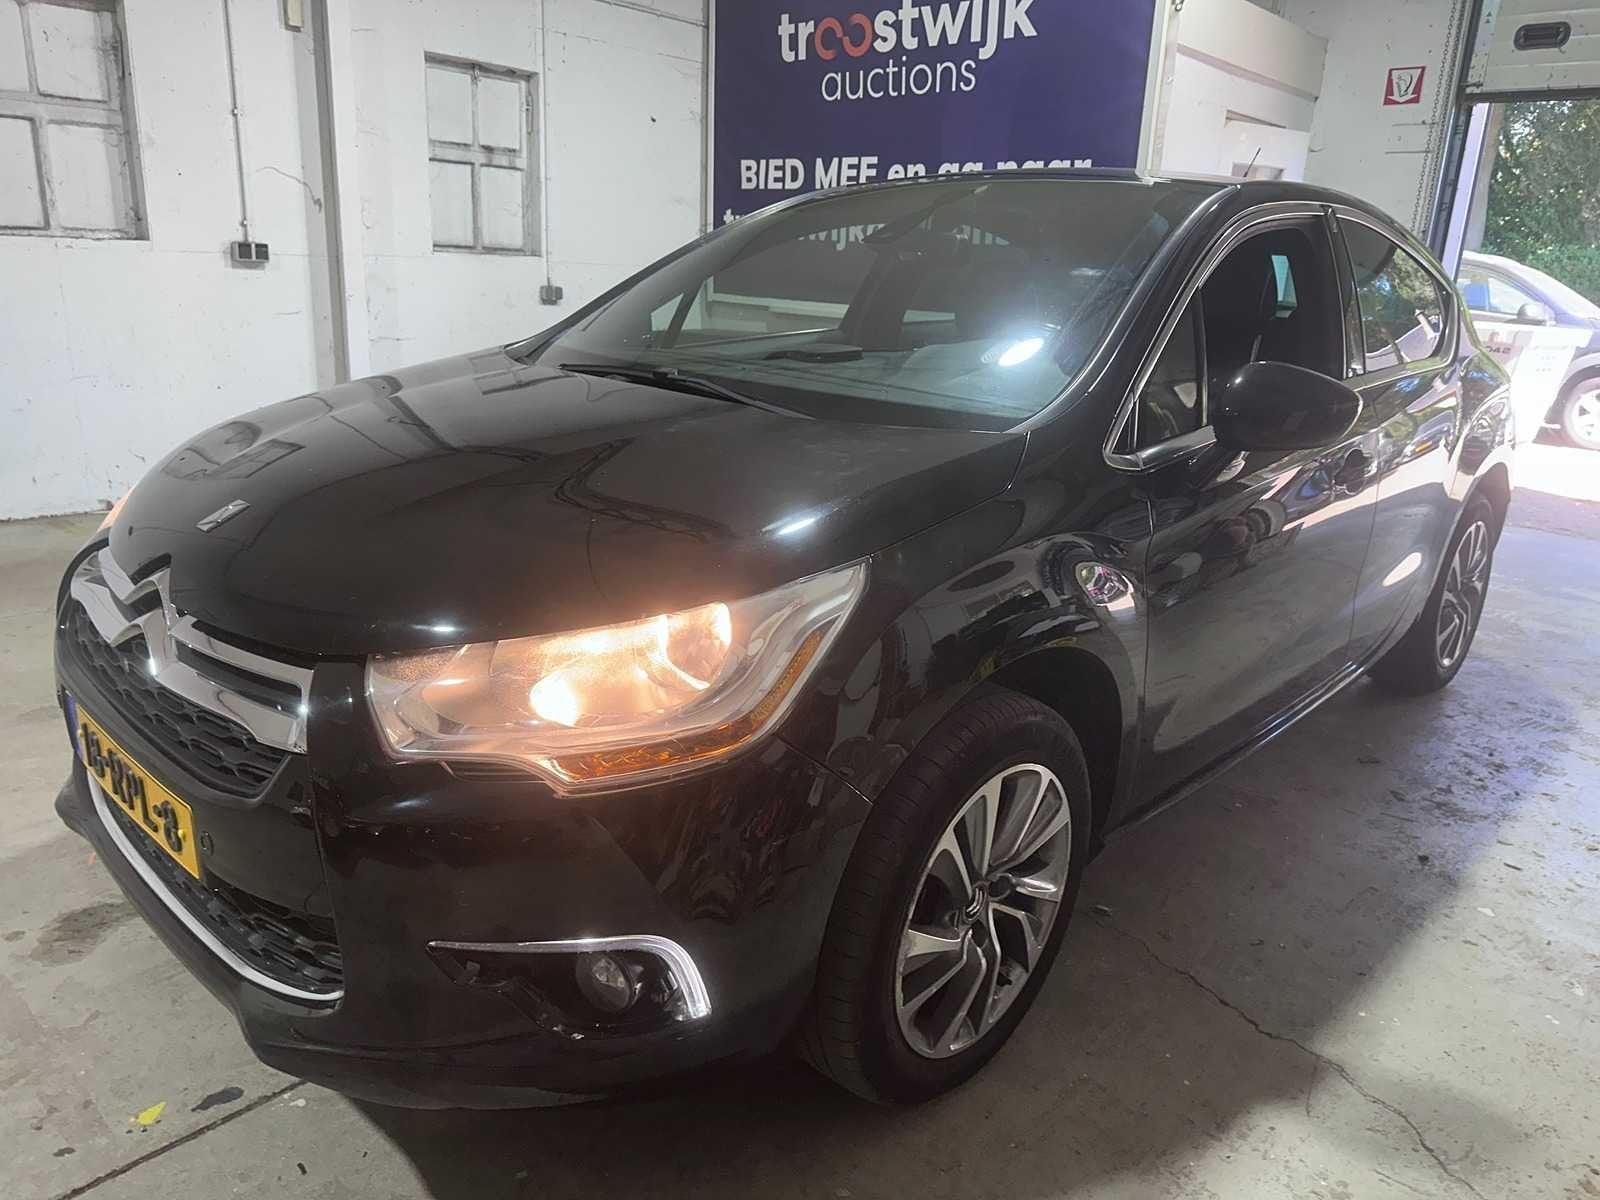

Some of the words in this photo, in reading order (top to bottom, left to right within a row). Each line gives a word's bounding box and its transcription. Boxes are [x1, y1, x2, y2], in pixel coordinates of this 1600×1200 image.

[777, 0, 1038, 62] troostwijk
[821, 56, 977, 101] auctions
[740, 158, 805, 190] BIED
